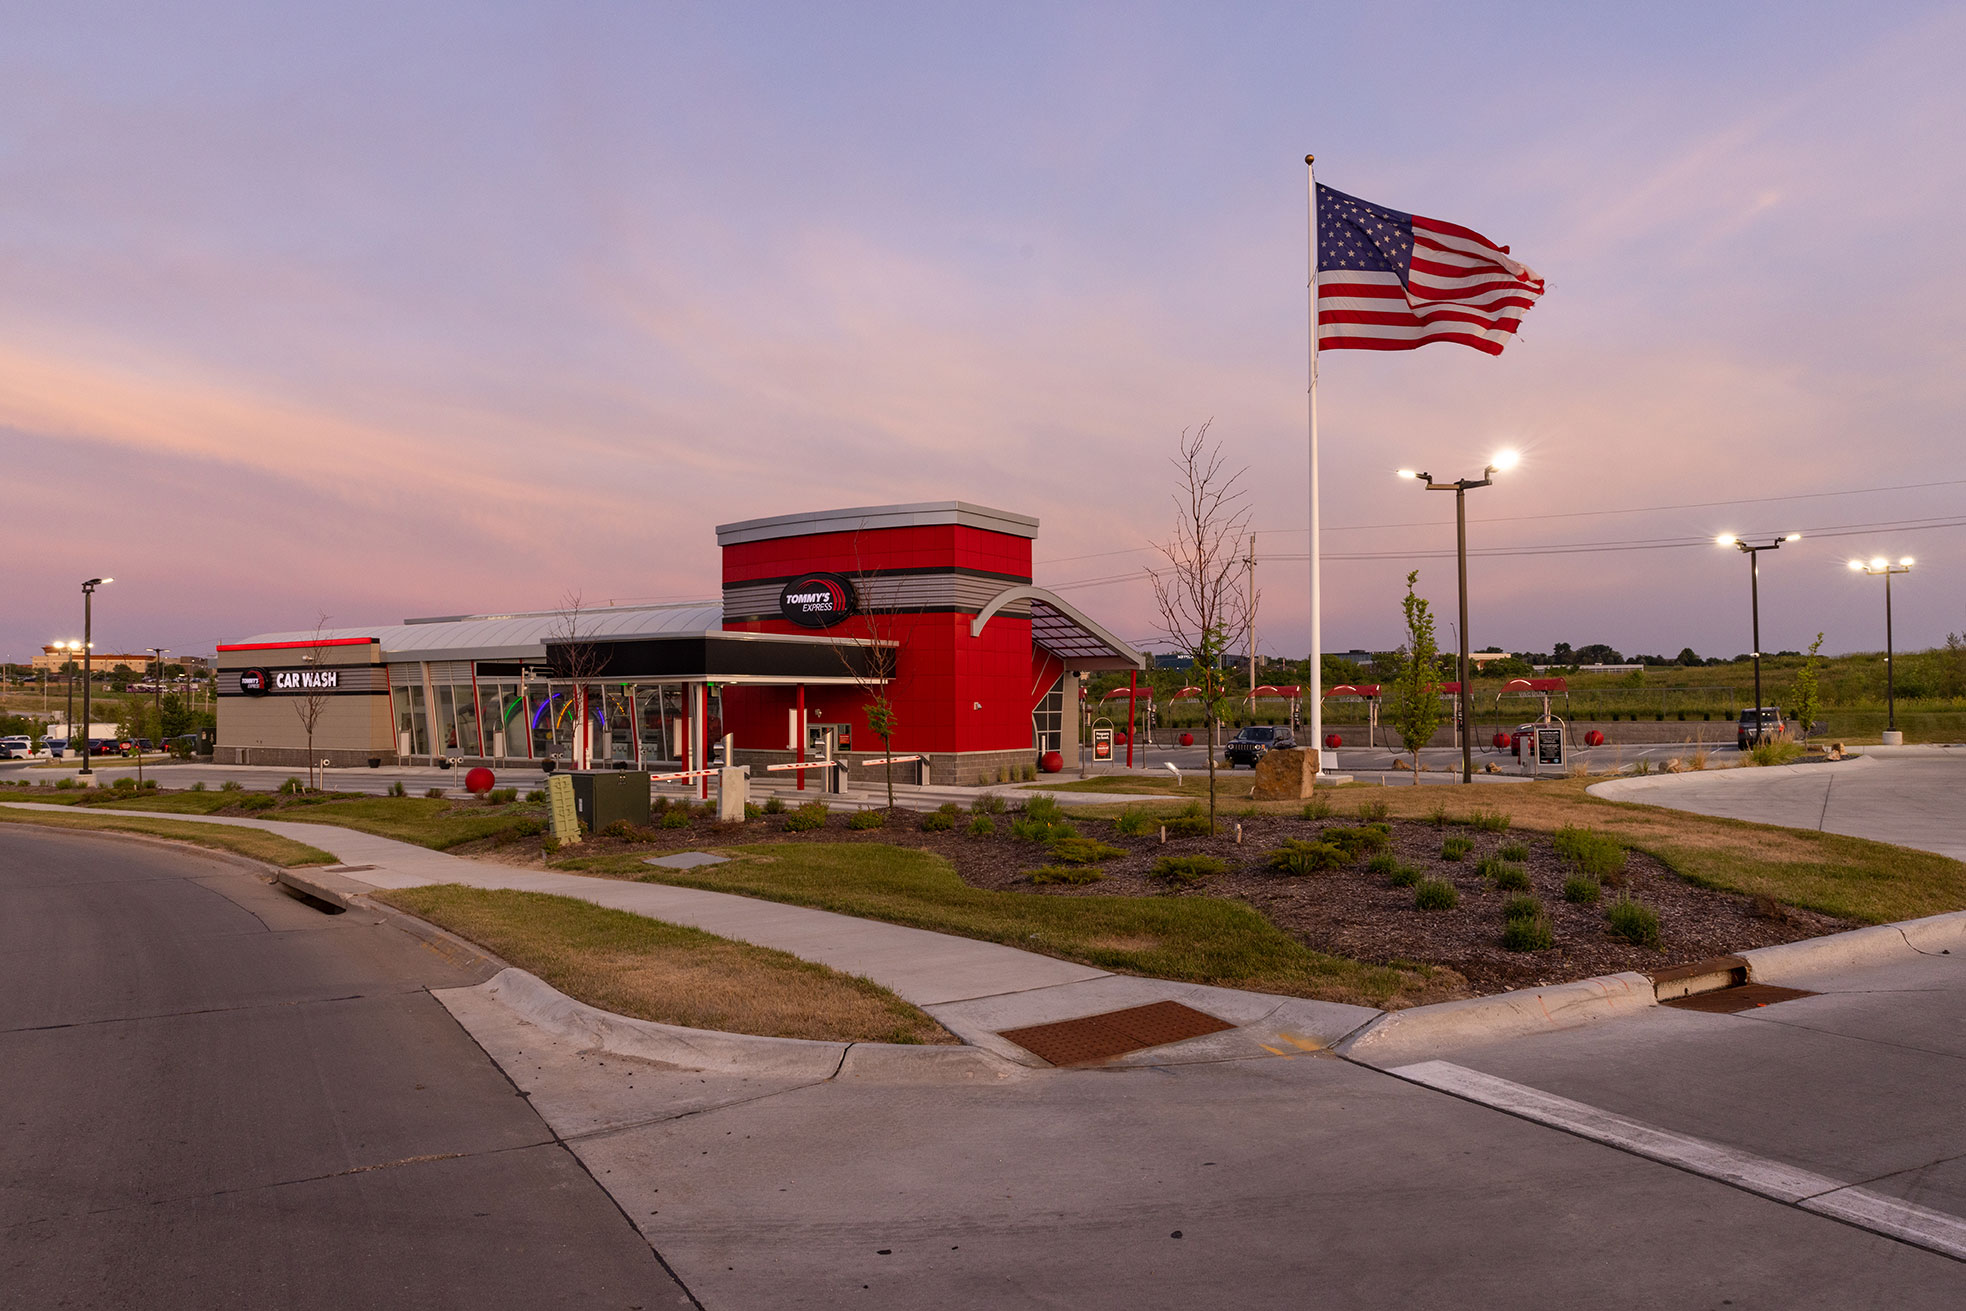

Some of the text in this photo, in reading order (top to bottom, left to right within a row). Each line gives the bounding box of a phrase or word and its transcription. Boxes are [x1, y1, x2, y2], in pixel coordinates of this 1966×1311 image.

[786, 592, 831, 604] TOMMY'S
[802, 602, 833, 612] EXPRESS
[276, 671, 337, 688] CAR WASH
